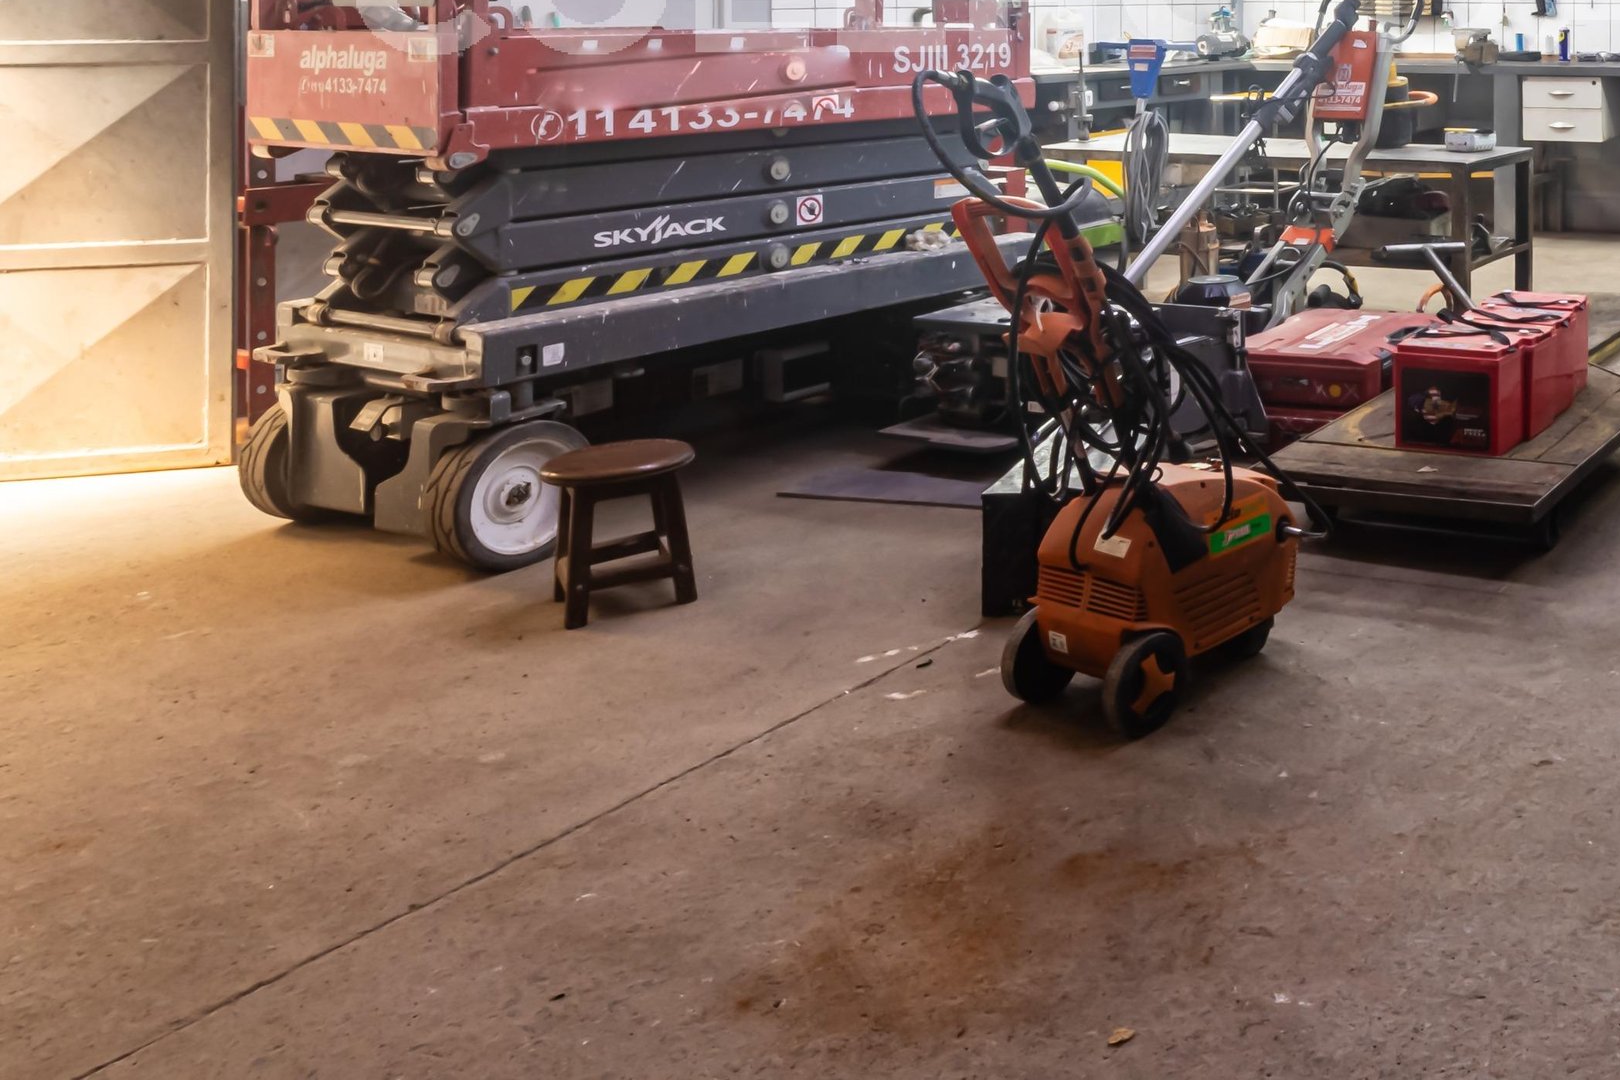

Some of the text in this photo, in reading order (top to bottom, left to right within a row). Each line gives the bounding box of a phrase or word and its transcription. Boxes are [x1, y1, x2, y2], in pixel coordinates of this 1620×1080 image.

[299, 44, 387, 76] alphaluga
[956, 42, 1012, 70] 3219
[567, 106, 614, 137] 11
[593, 214, 727, 248] SKYJACK
